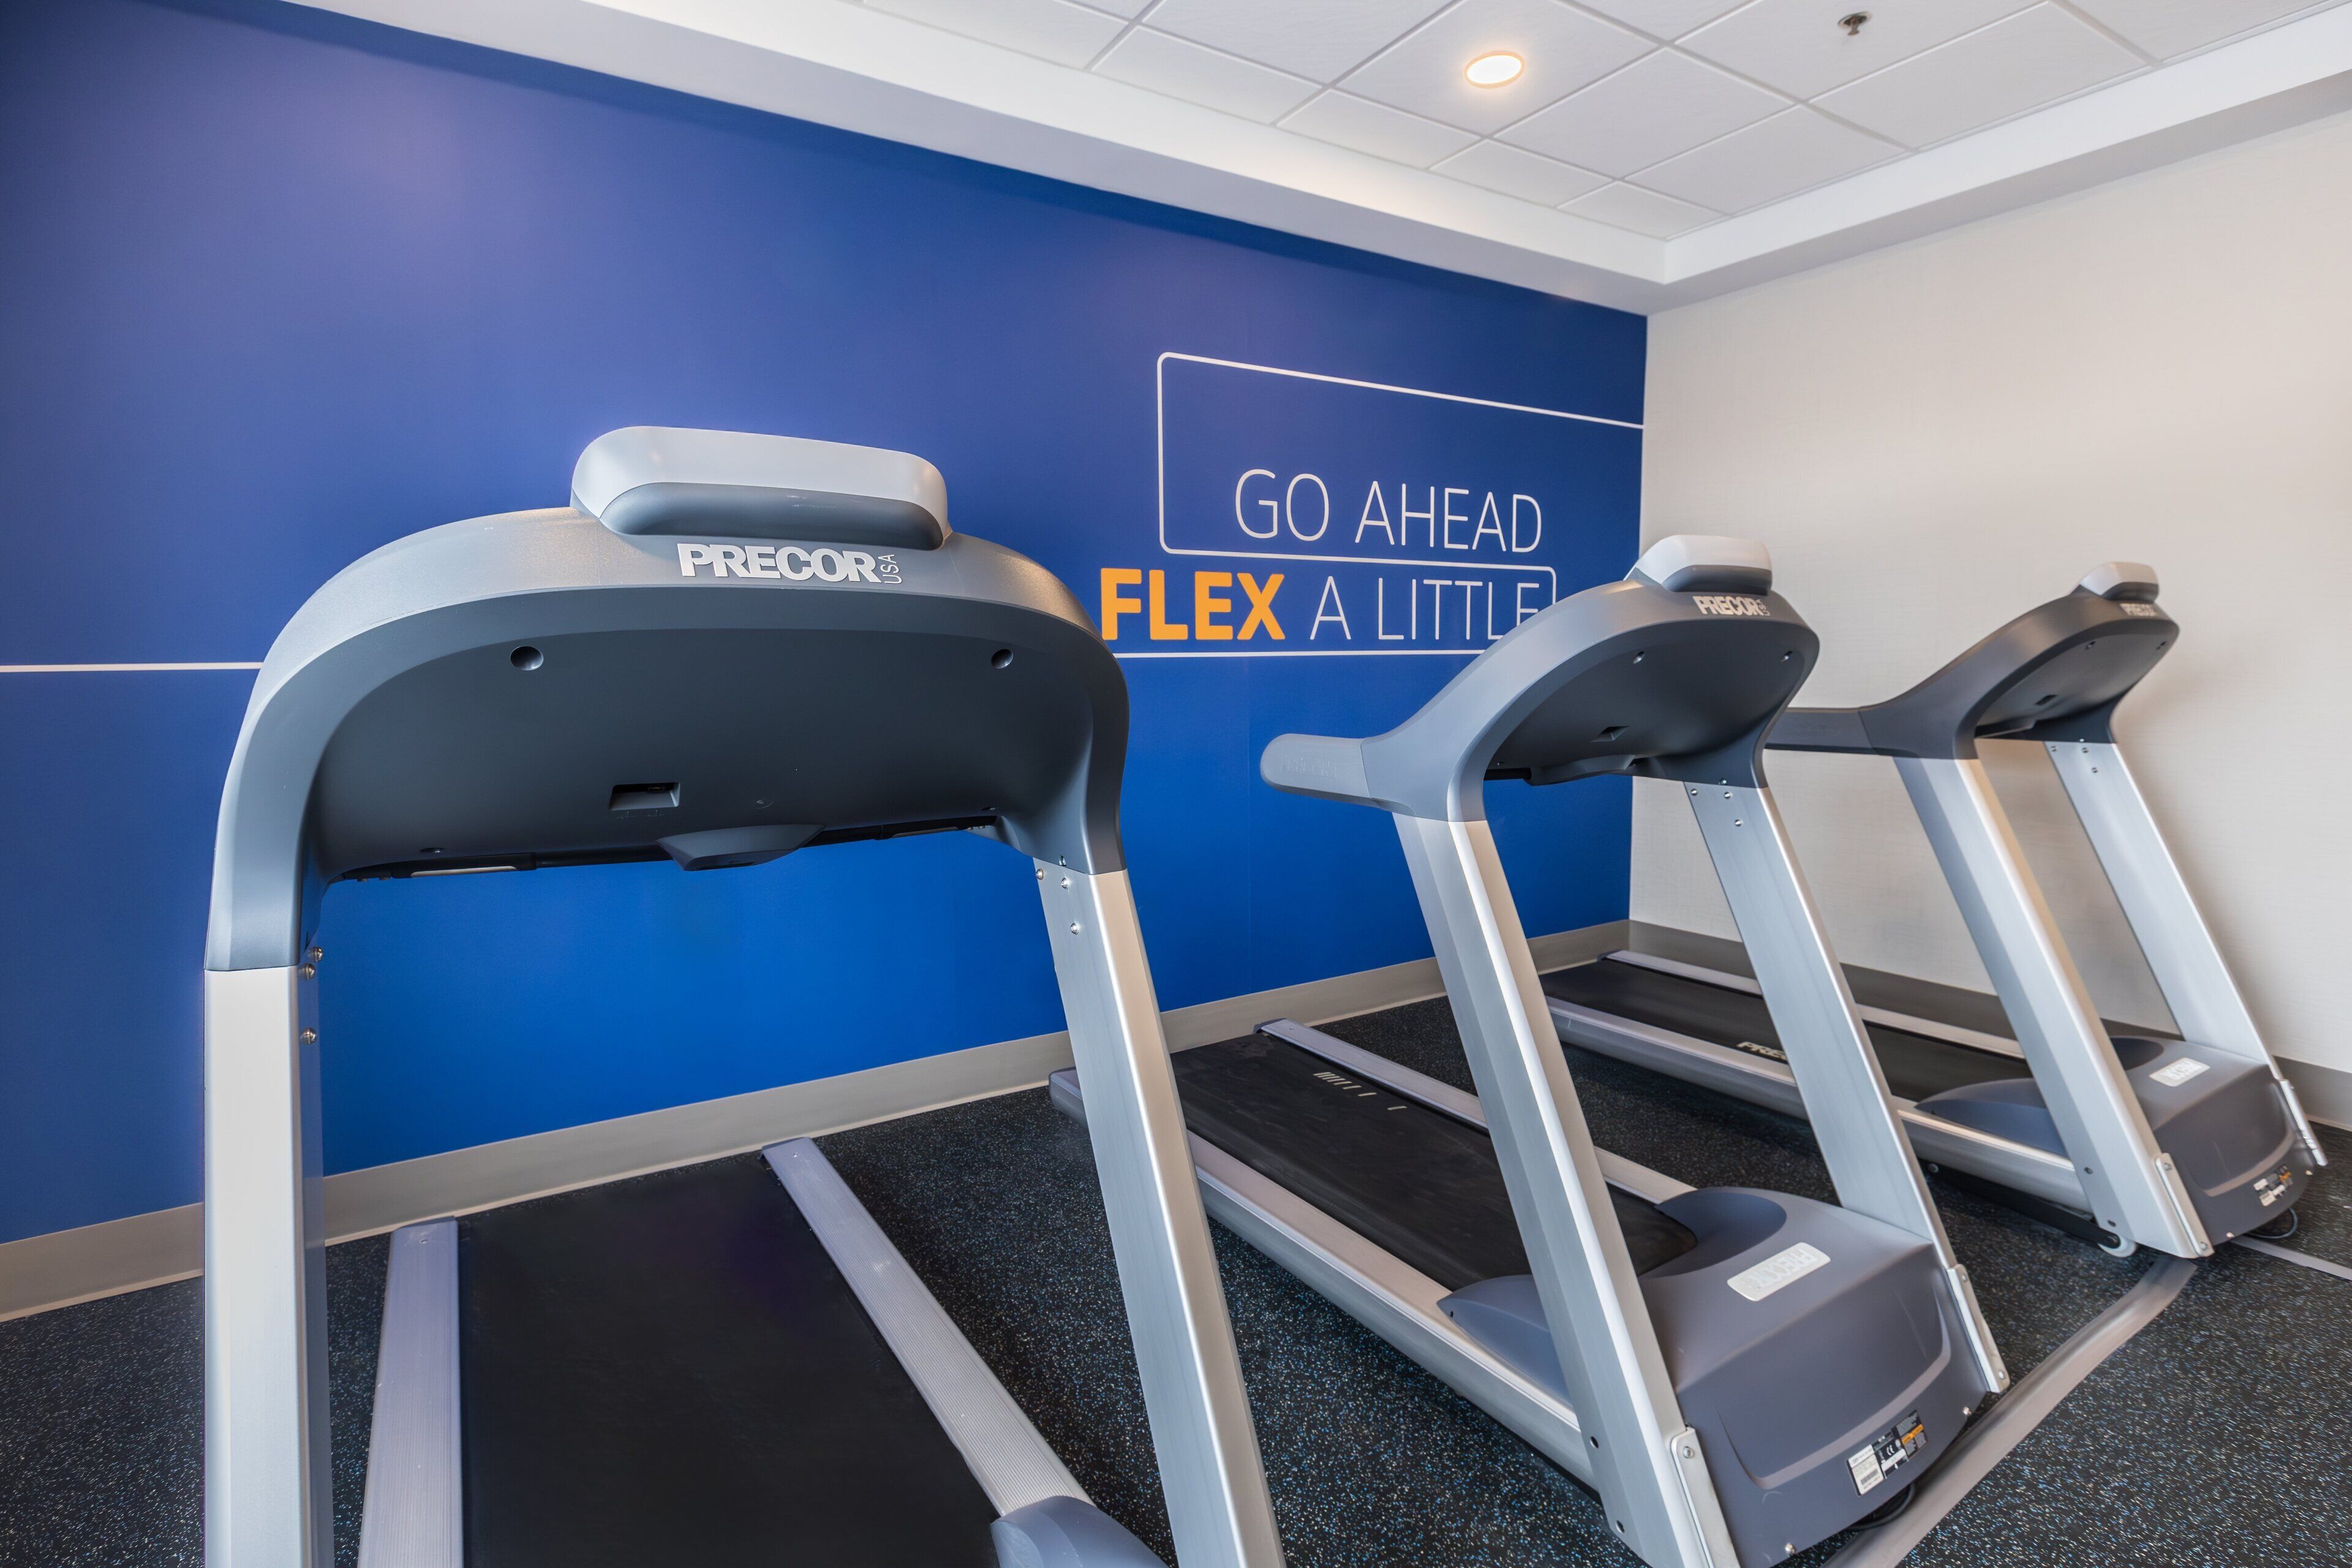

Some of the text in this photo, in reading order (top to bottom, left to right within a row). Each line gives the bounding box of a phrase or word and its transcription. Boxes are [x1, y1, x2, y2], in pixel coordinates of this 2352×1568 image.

[1235, 469, 1542, 552] GO AHEAD
[677, 543, 903, 584] PRECOR USA
[1101, 567, 1540, 640] FLEX A LITTLE
[1692, 596, 1765, 616] PRECOR
